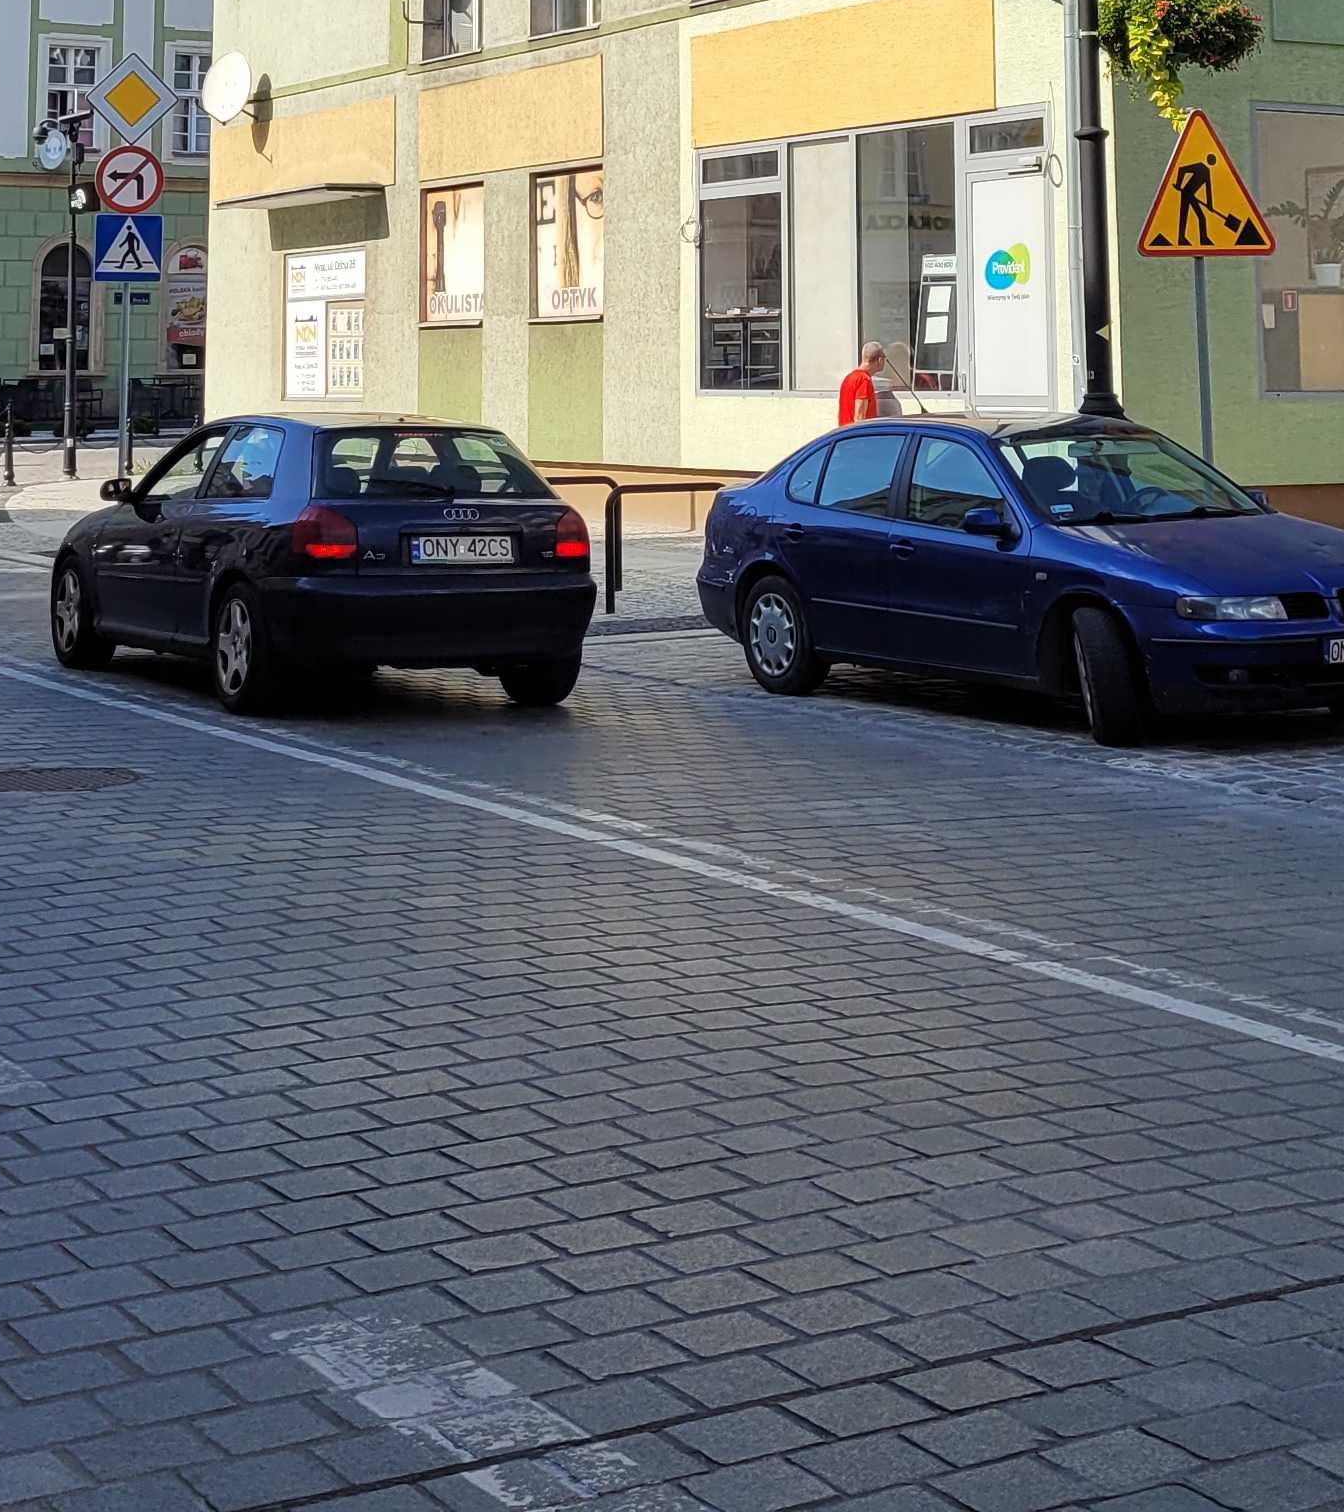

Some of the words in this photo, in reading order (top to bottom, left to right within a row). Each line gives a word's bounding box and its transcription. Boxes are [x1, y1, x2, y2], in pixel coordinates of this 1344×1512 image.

[552, 288, 598, 313] OPTYK
[422, 538, 460, 557] ONY
[467, 538, 509, 557] 42CS
